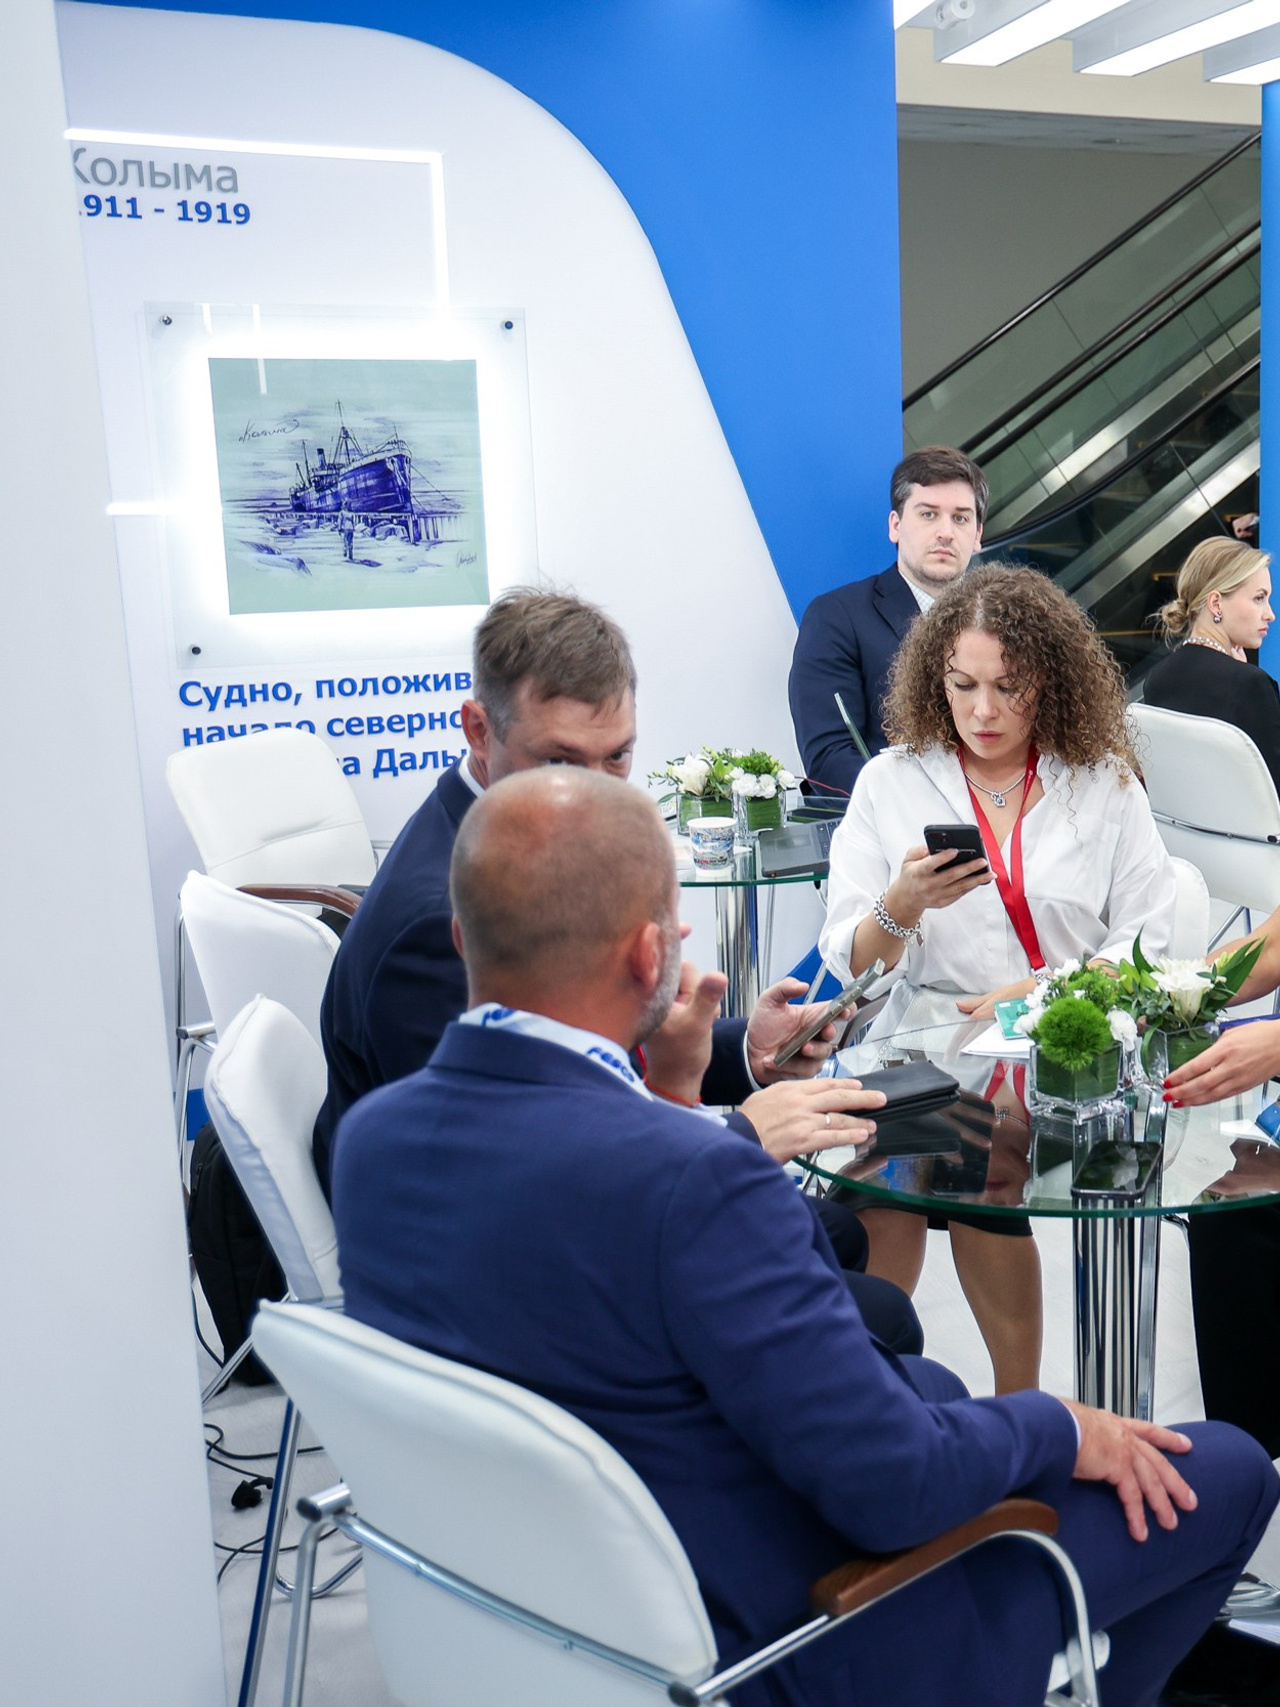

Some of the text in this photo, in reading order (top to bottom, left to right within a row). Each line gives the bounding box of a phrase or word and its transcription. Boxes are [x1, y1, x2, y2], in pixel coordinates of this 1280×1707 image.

[79, 194, 142, 219] 911
[176, 199, 251, 225] 1919
[178, 671, 473, 712] Судно, положив
[372, 748, 467, 779] Даль
